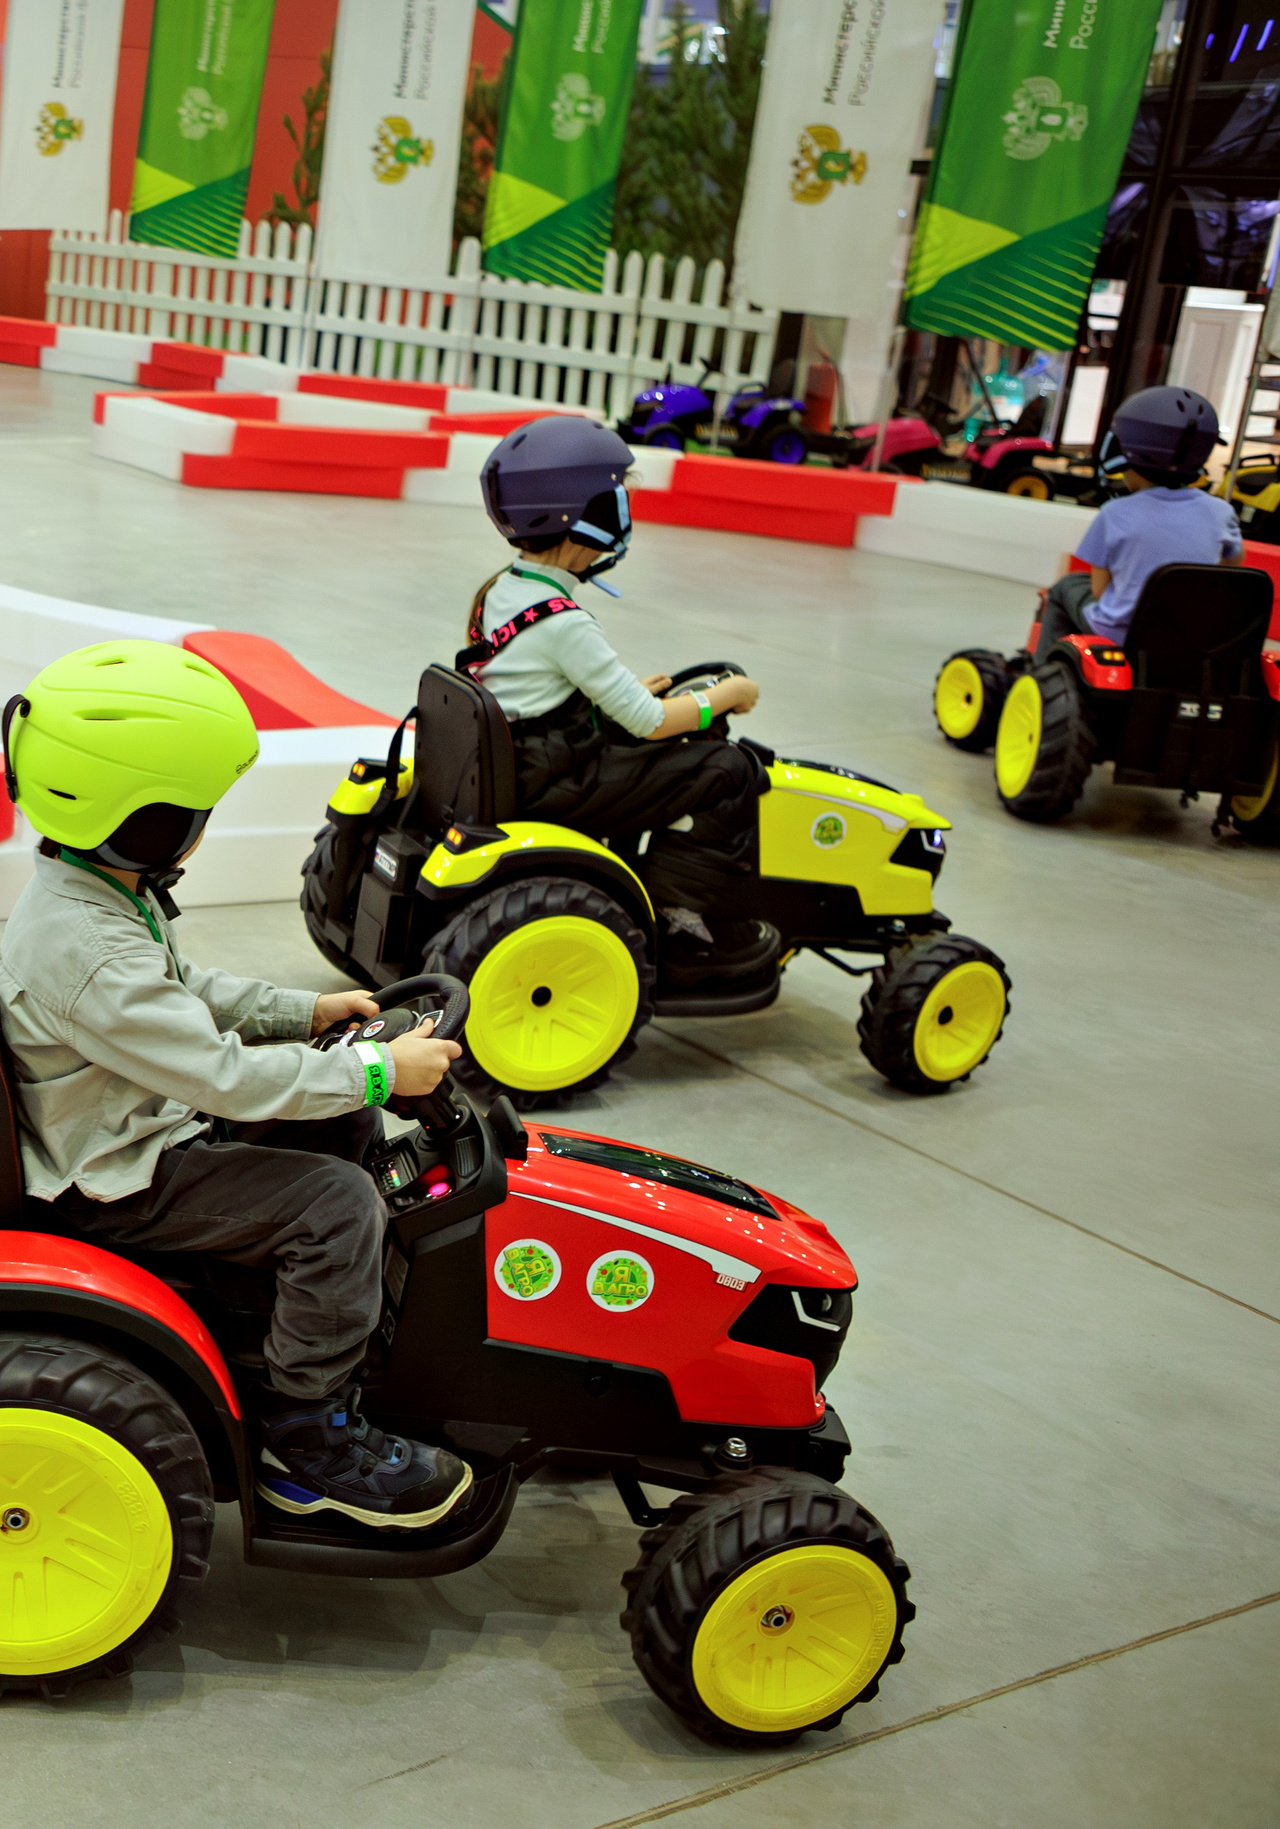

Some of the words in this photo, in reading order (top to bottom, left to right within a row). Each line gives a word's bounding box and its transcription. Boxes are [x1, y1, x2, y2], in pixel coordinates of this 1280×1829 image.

[504, 1249, 520, 1261] В
[525, 1259, 546, 1275] Я
[613, 1266, 630, 1284] Я
[510, 1262, 534, 1297] АГРО
[592, 1281, 605, 1295] В
[606, 1282, 648, 1298] АГРО
